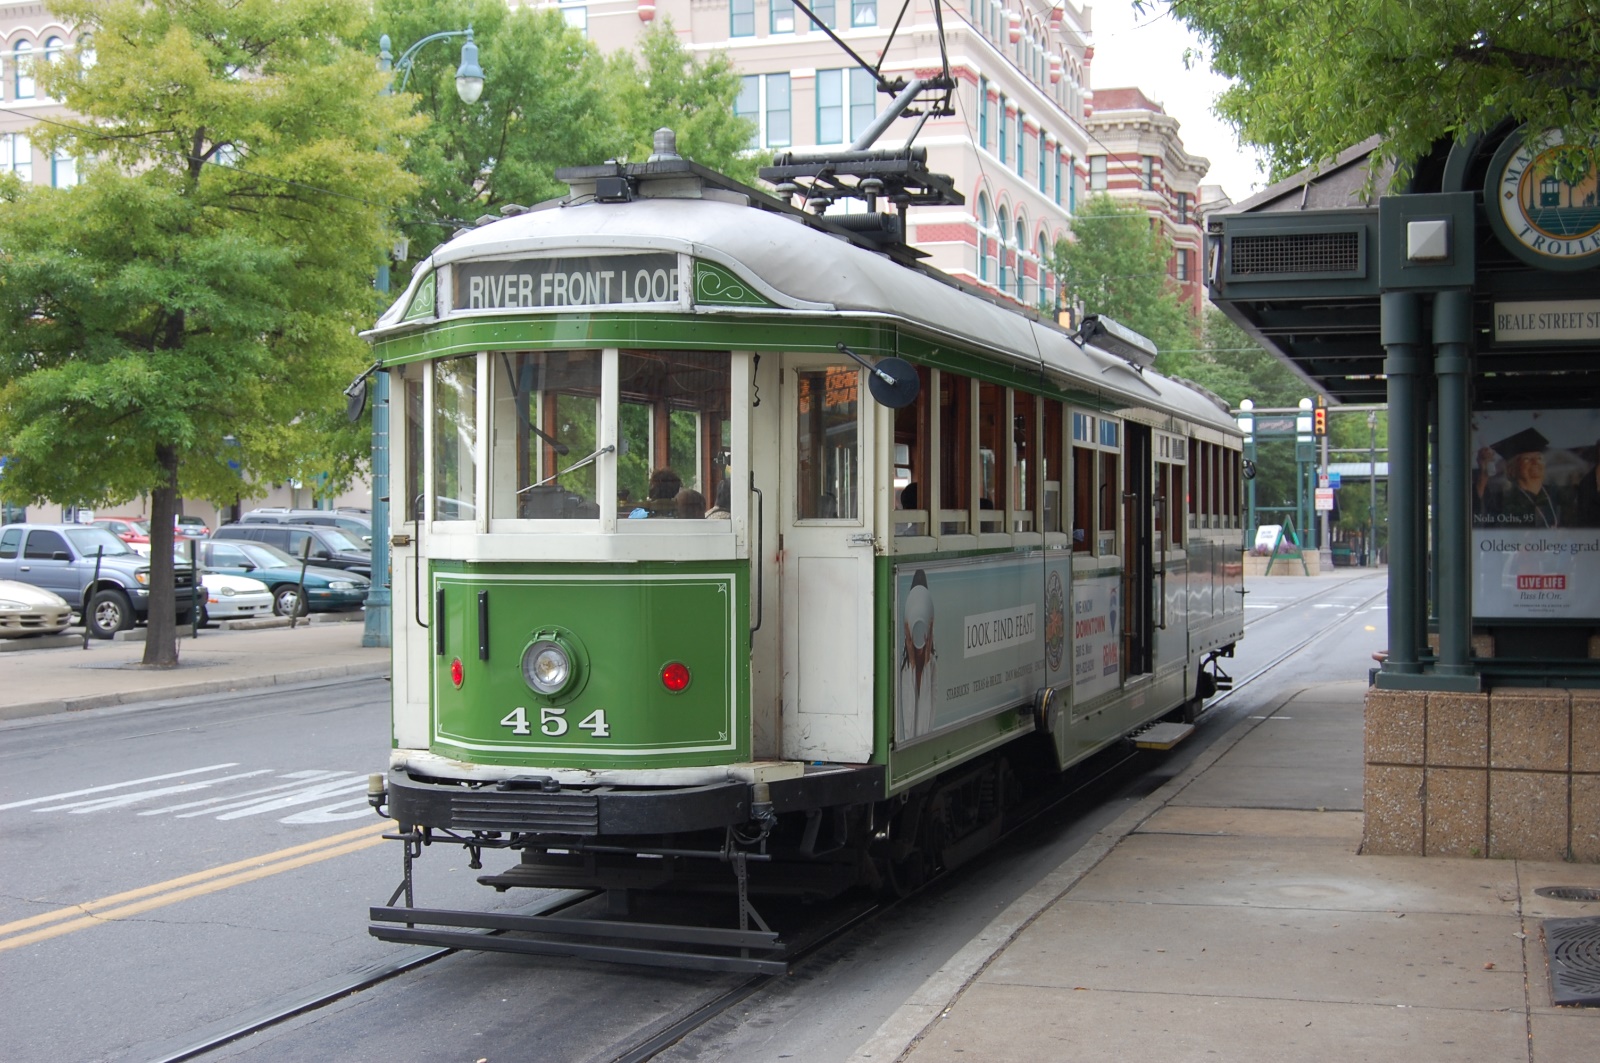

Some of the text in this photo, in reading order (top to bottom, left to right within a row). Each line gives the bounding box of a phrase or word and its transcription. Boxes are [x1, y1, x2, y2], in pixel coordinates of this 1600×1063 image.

[469, 273, 533, 309] RIVER
[540, 270, 615, 307] FRONT
[1497, 313, 1536, 331] BEALE
[1538, 312, 1584, 330] STREET
[1473, 513, 1535, 524] Nola Ochs, 95
[1480, 539, 1521, 552] Oldest
[1524, 538, 1568, 555] college
[1520, 577, 1563, 589] LIVE LIFE
[1520, 591, 1536, 601] Pass
[1537, 591, 1545, 601] It
[993, 617, 1014, 644] FIND.
[1015, 612, 1035, 638] FEAST.
[1075, 614, 1106, 639] DOWNTOWN
[500, 706, 611, 738] 454
